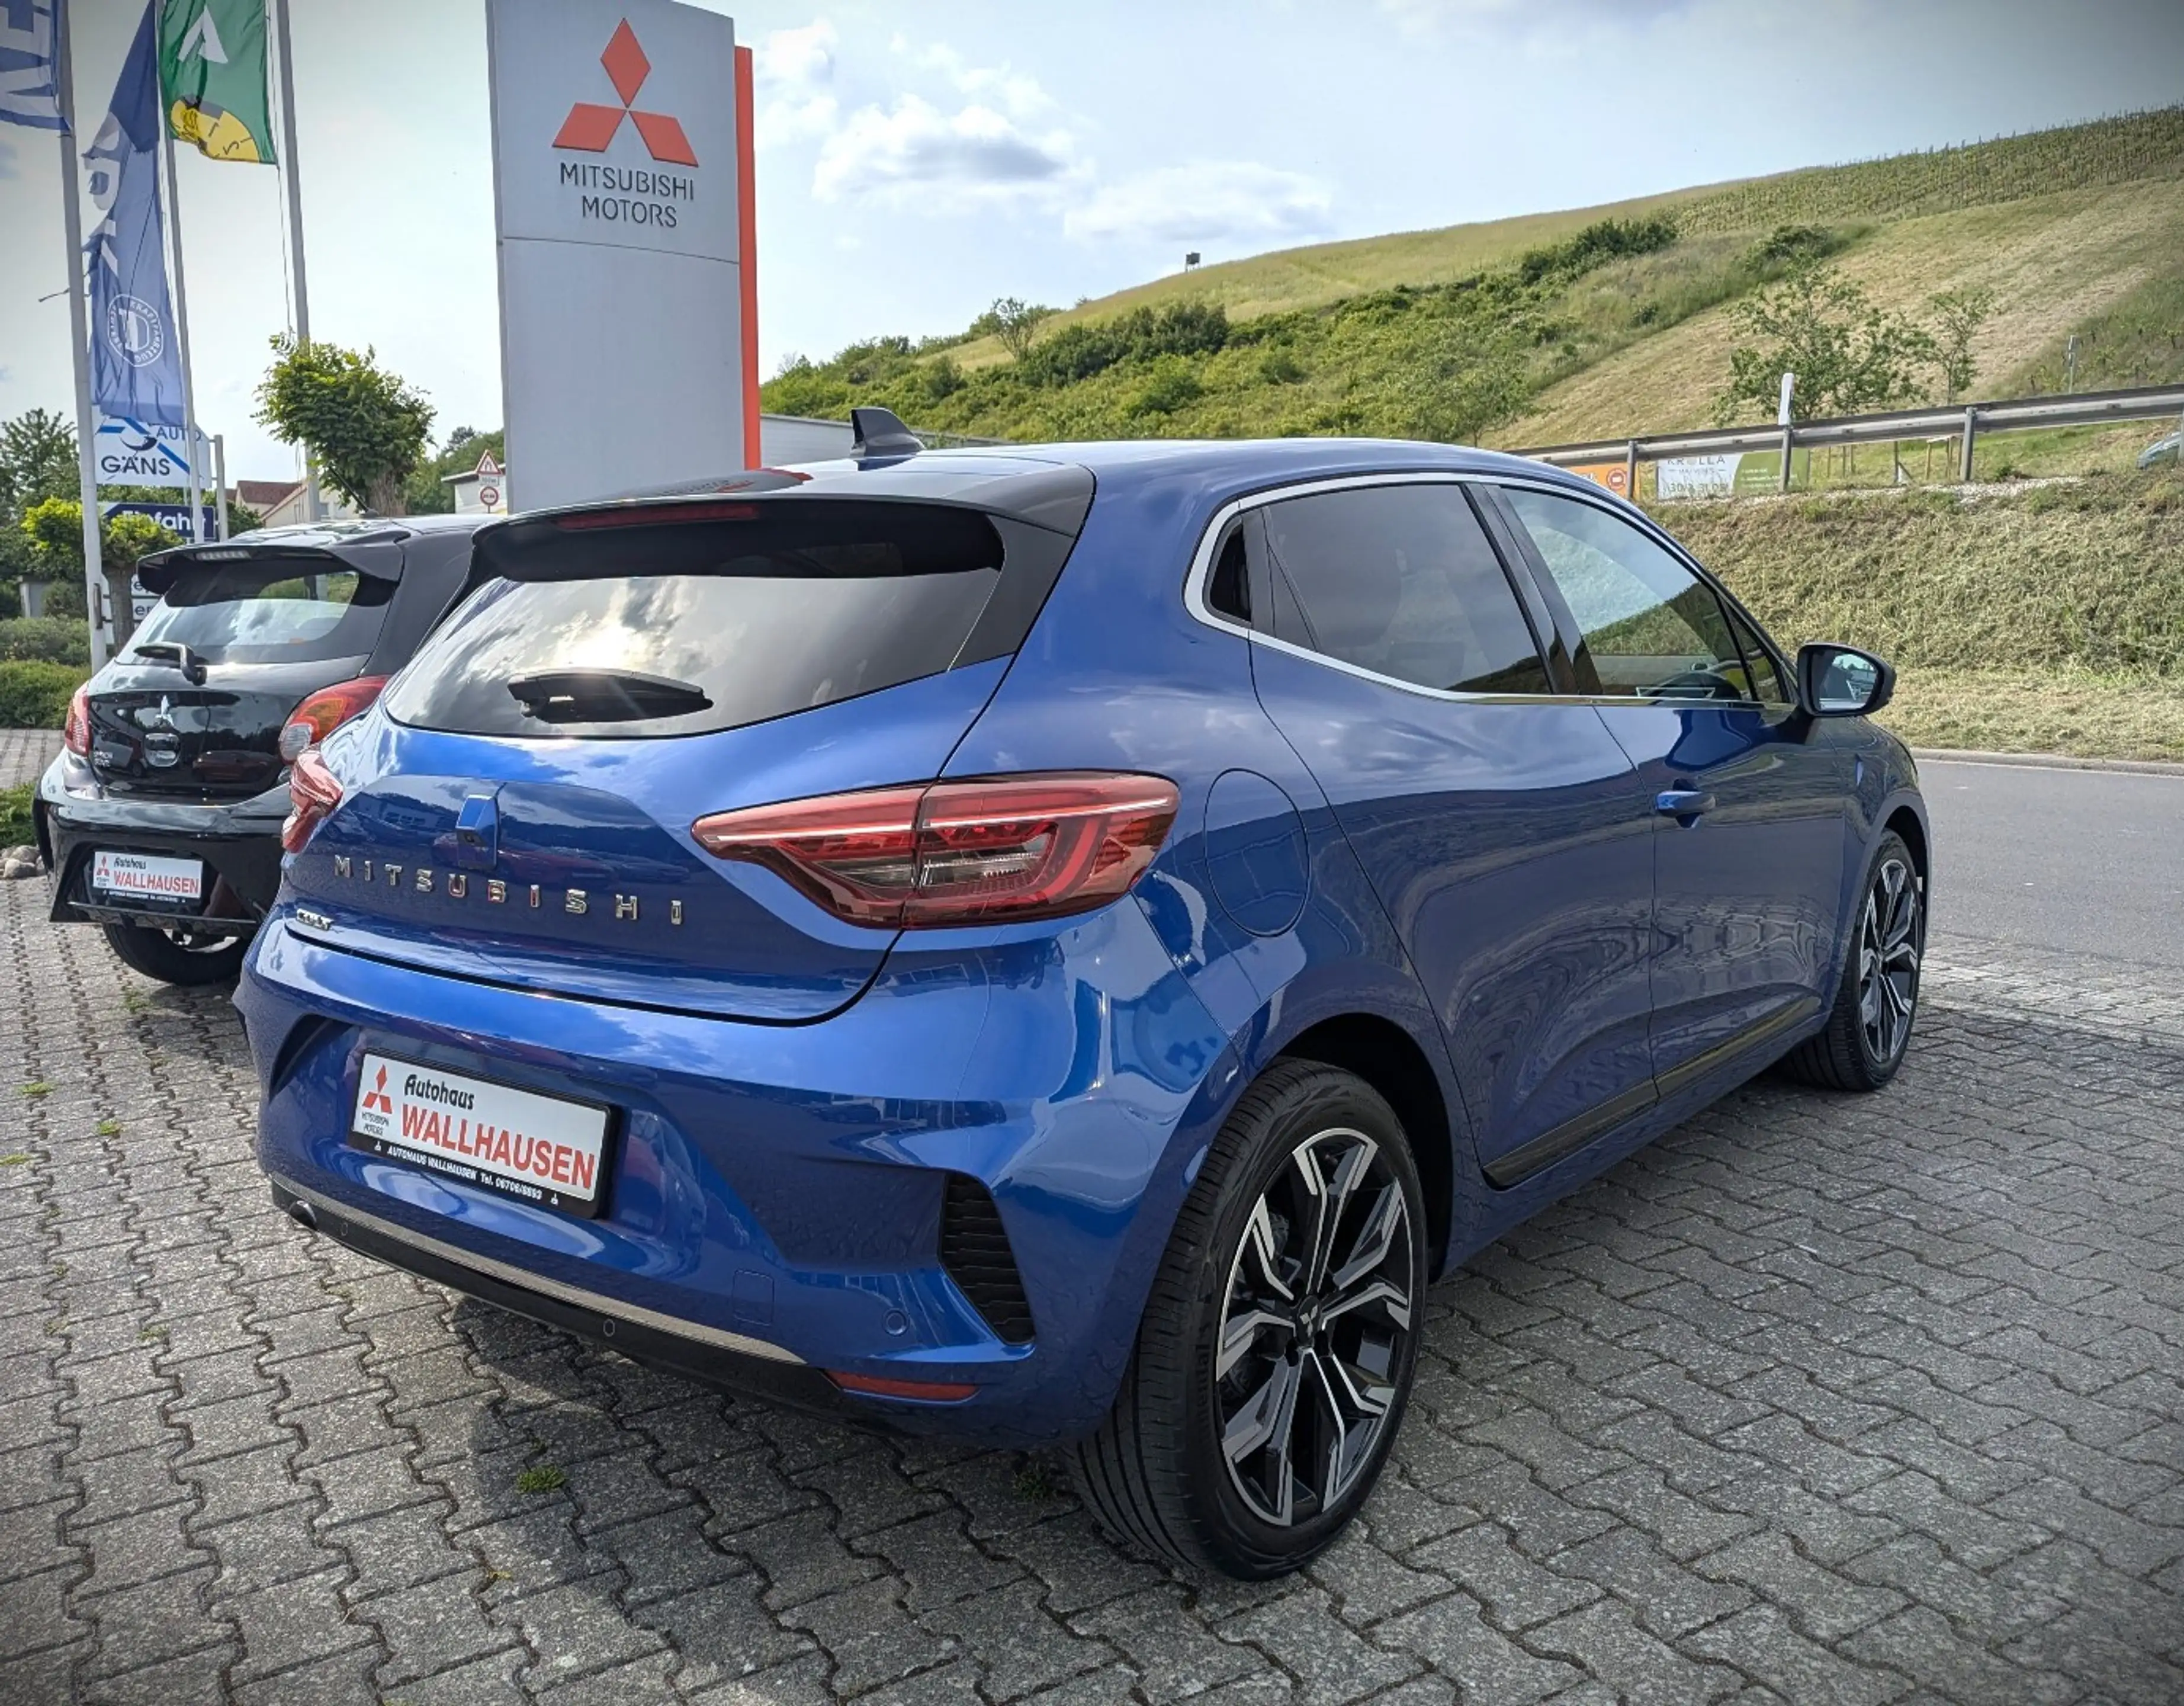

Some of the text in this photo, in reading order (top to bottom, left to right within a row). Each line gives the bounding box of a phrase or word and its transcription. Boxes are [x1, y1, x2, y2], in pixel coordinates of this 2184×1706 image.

[560, 162, 695, 201] MITSUBISHI
[582, 195, 677, 228] MOTORS
[101, 454, 171, 476] GÄNS
[114, 870, 199, 893] WALLHAUSEN
[335, 854, 683, 925] MITSUBISHI
[404, 1074, 474, 1109] Autohaus
[387, 1146, 427, 1166] AUTOHAUS
[428, 1157, 477, 1181] WALLHAUSEN
[402, 1104, 595, 1189] WALLHAUSEN
